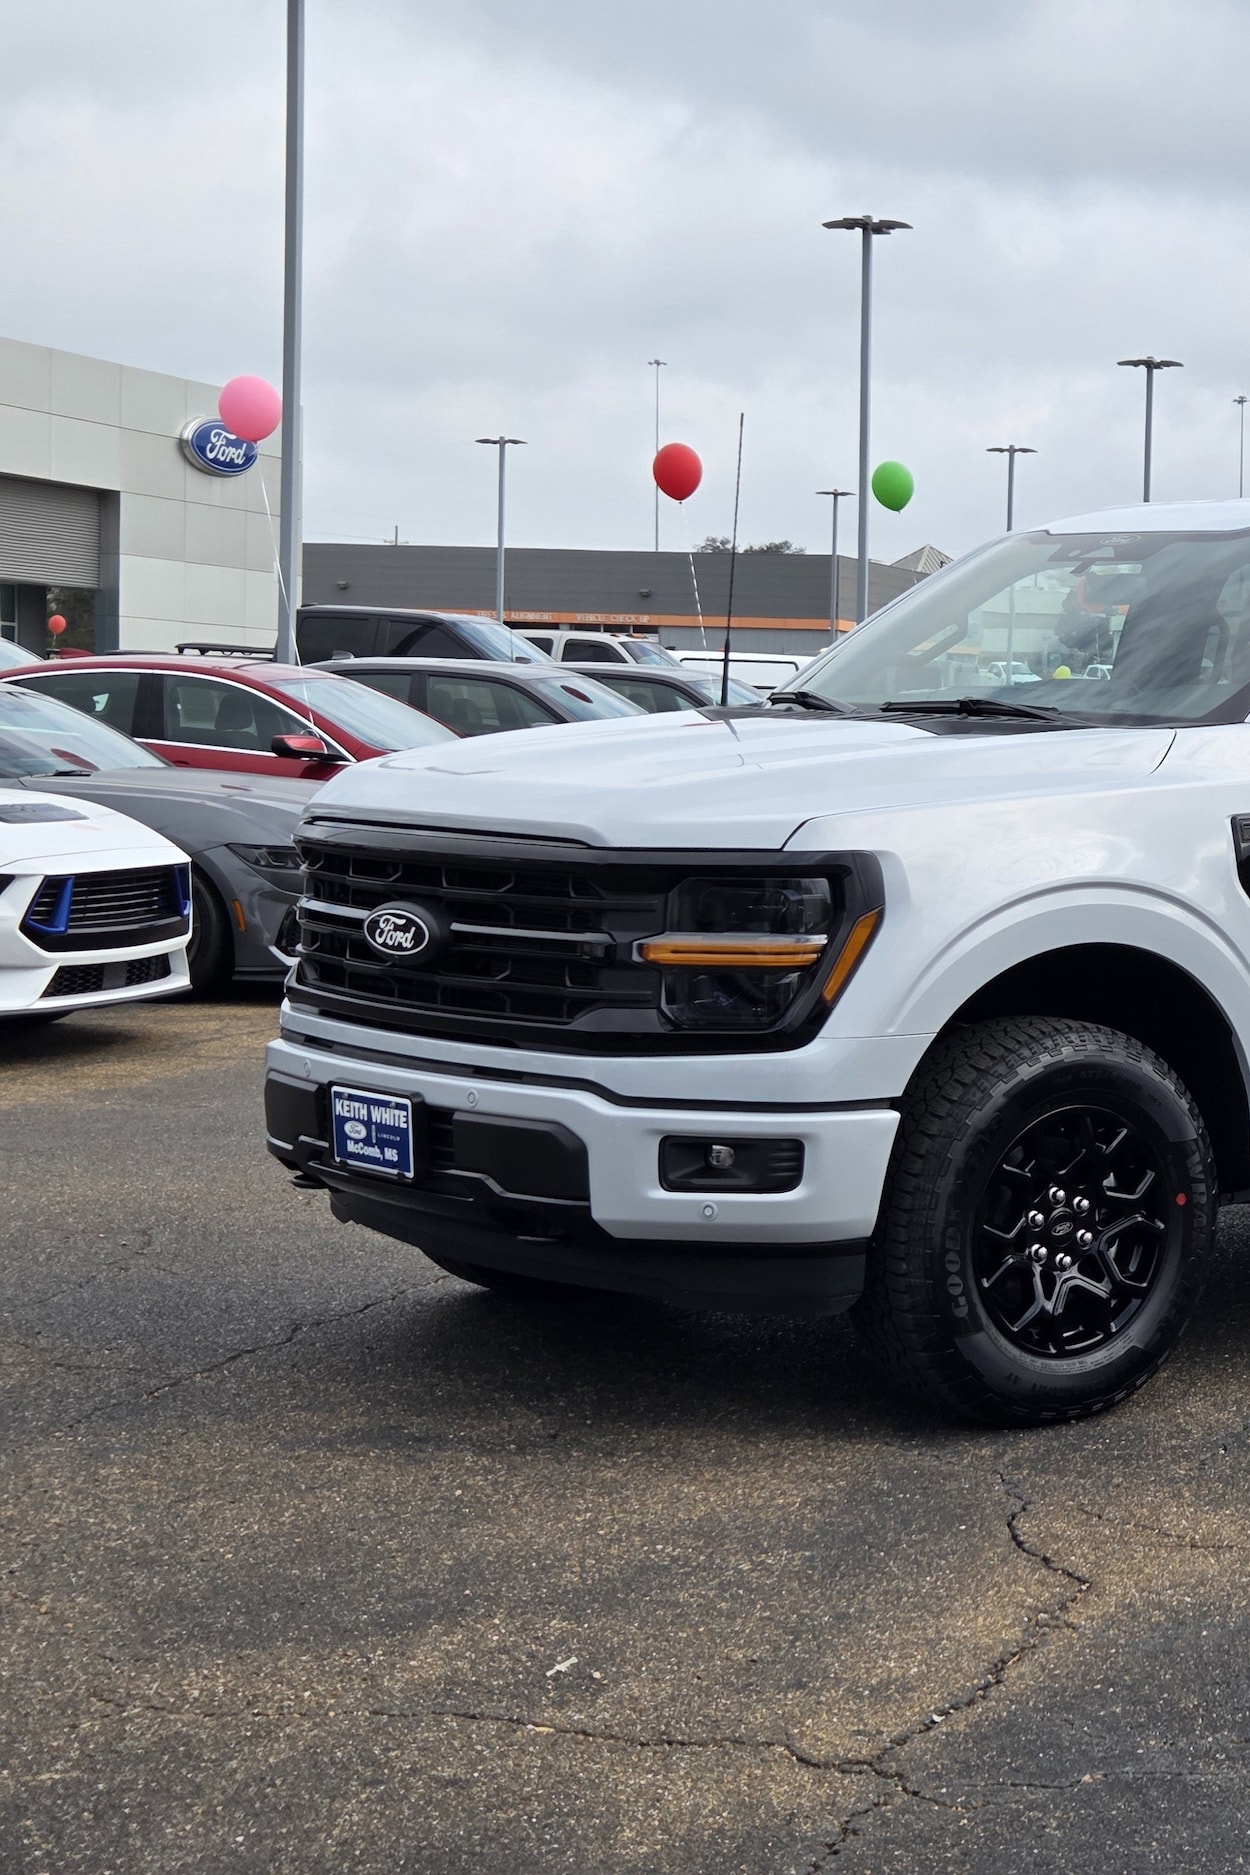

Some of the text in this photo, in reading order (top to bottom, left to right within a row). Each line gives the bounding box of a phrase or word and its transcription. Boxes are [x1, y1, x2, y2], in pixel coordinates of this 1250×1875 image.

[206, 429, 247, 464] Ford
[611, 614, 637, 622] CHECK
[639, 615, 650, 623] UP
[375, 914, 416, 949] Ford
[335, 1098, 408, 1129] KEITH WHITE
[348, 1123, 363, 1136] Ford
[346, 1139, 399, 1162] McComb, MS
